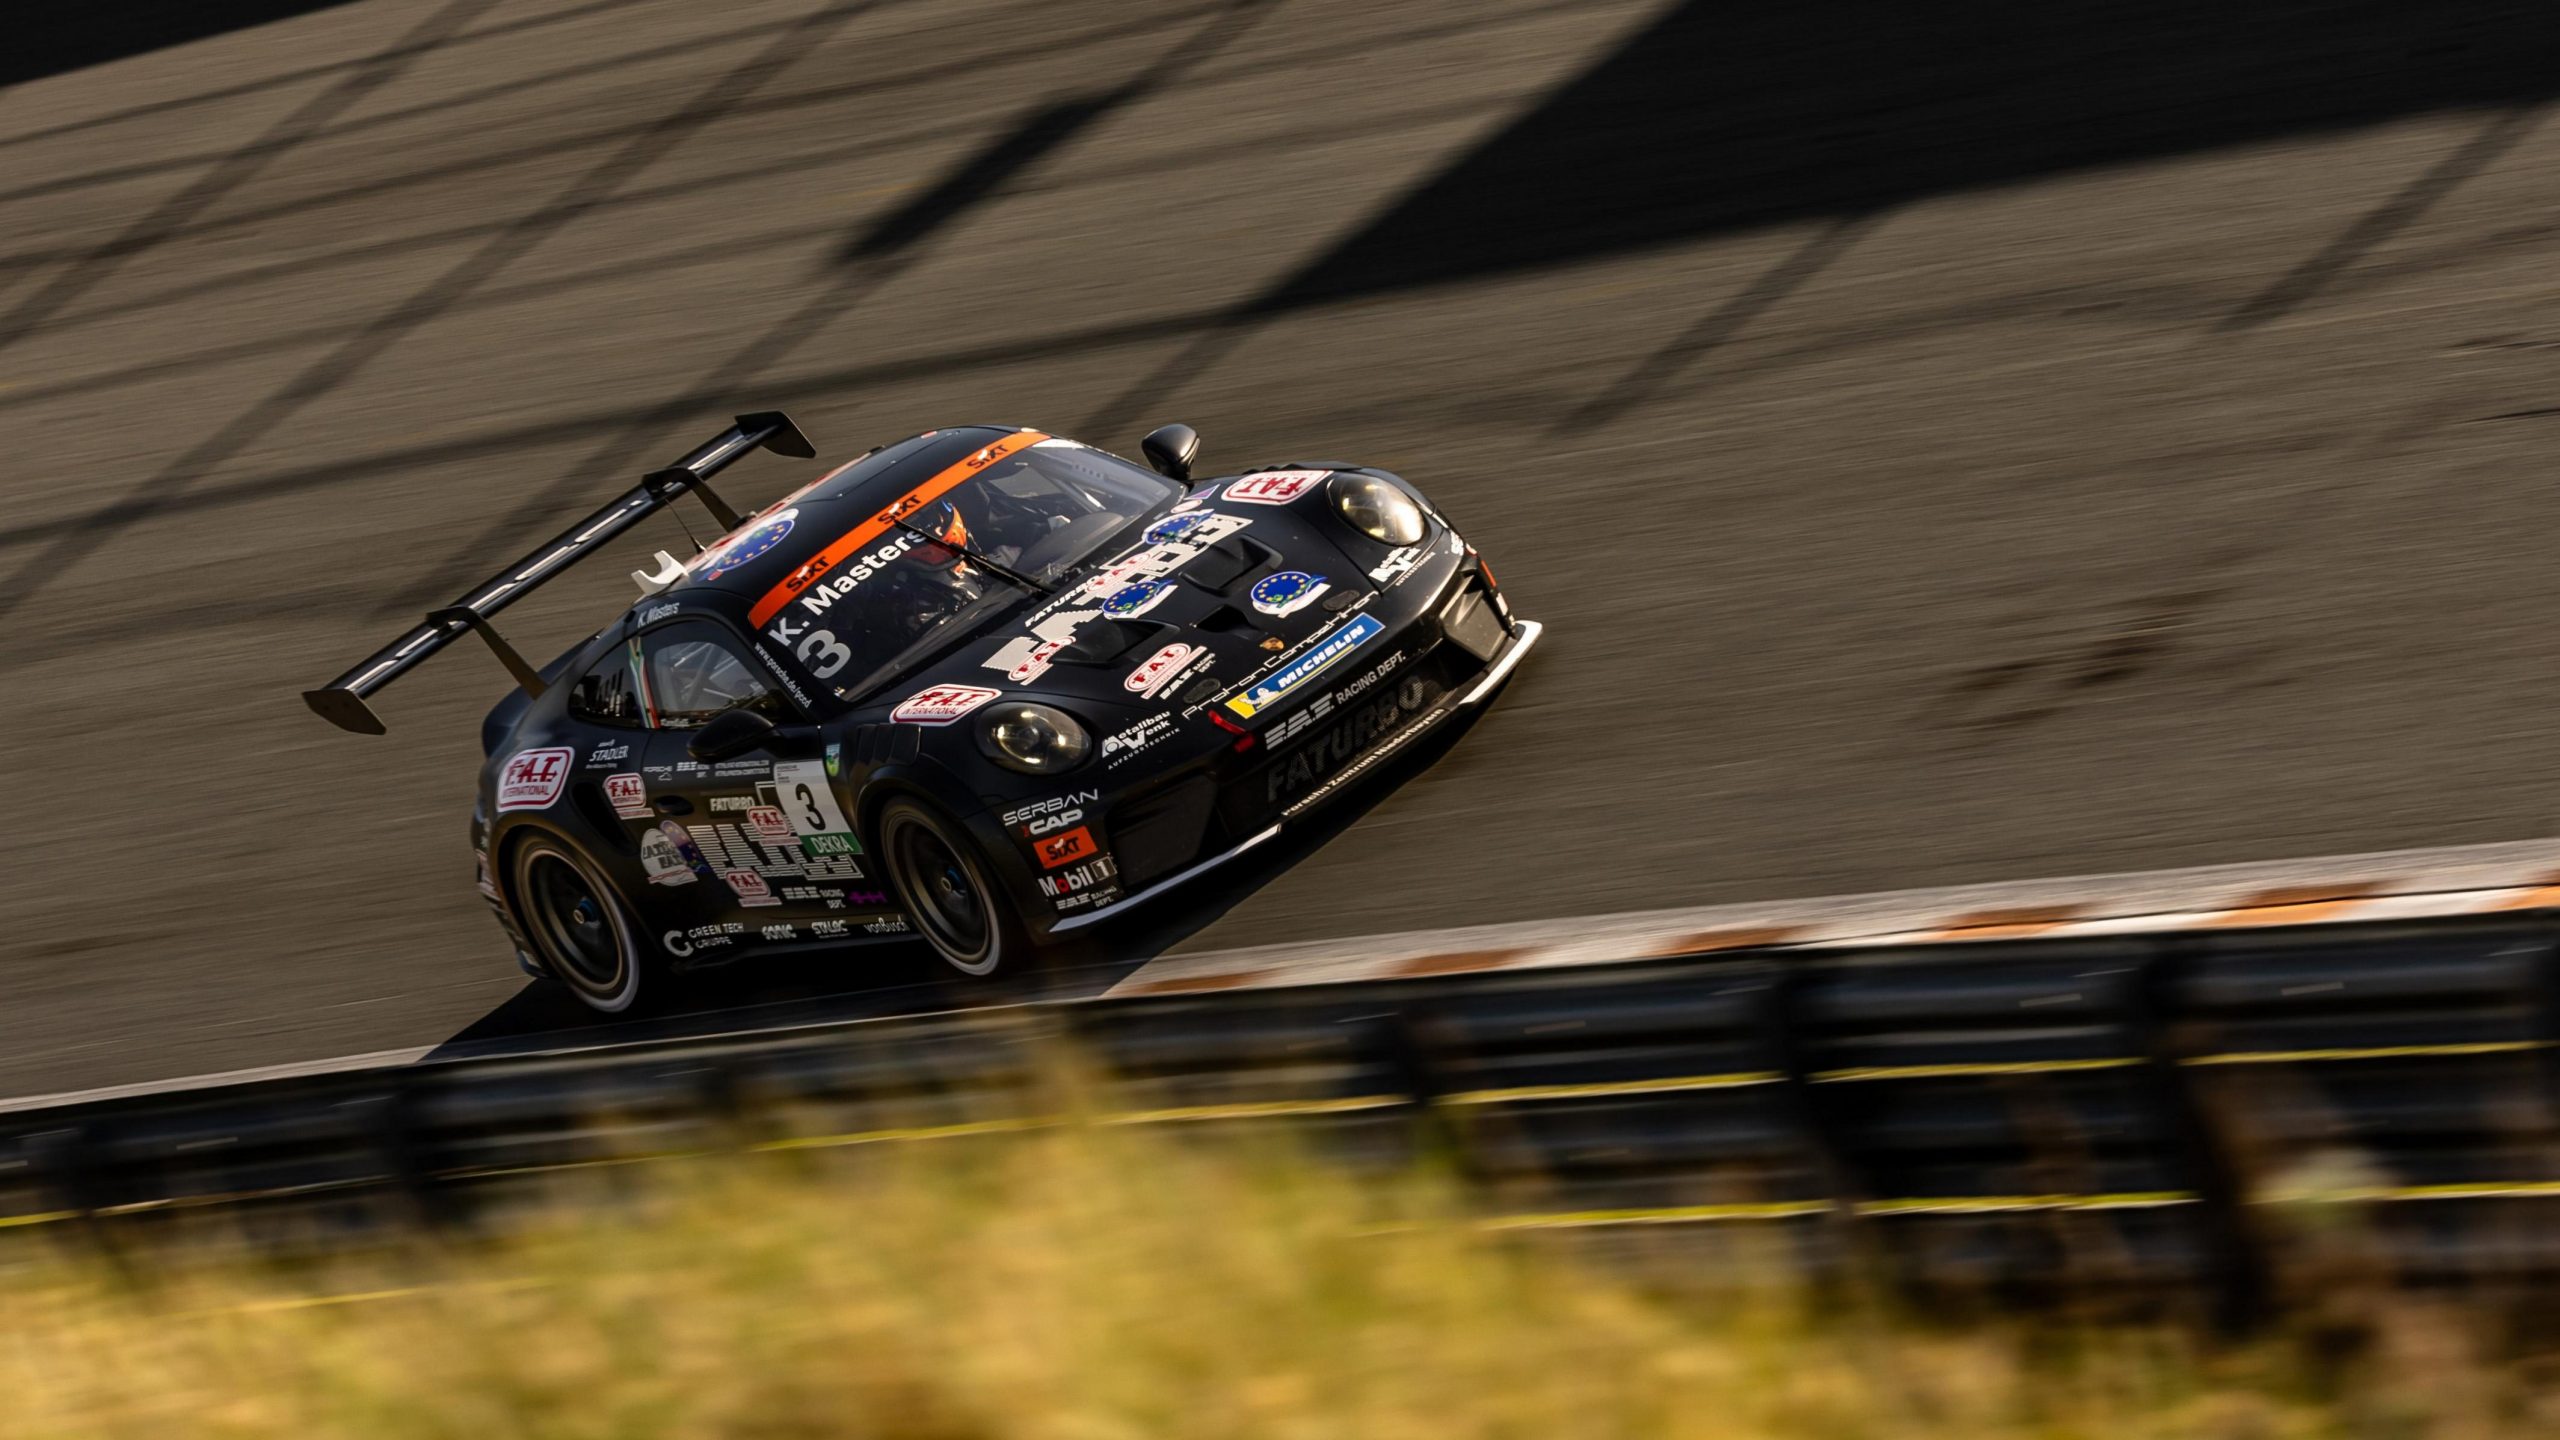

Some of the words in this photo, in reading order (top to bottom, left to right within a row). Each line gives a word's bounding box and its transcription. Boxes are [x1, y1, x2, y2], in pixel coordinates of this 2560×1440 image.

[967, 444, 1008, 470] SIXT
[877, 494, 922, 526] SIXT
[768, 617, 810, 647] K.
[800, 531, 928, 617] Masters
[786, 556, 829, 592] SIXT
[647, 602, 680, 623] Masters
[797, 629, 851, 680] 3
[1278, 624, 1366, 689] MICHELIN
[1336, 671, 1378, 705] RACING
[1376, 650, 1407, 679] DEPT.
[589, 745, 630, 763] STADLER
[1267, 675, 1424, 803] FATURBO
[1327, 753, 1378, 788] Zentrum
[710, 796, 755, 812] FATURBO
[795, 783, 827, 831] 3
[1002, 788, 1099, 827] SERBAN
[1029, 808, 1083, 836] CAP
[810, 835, 854, 854] DEKRA
[1045, 836, 1081, 861] SIXT
[1038, 864, 1095, 897] Mobil
[687, 924, 722, 939] GREEN
[722, 922, 745, 934] TECH
